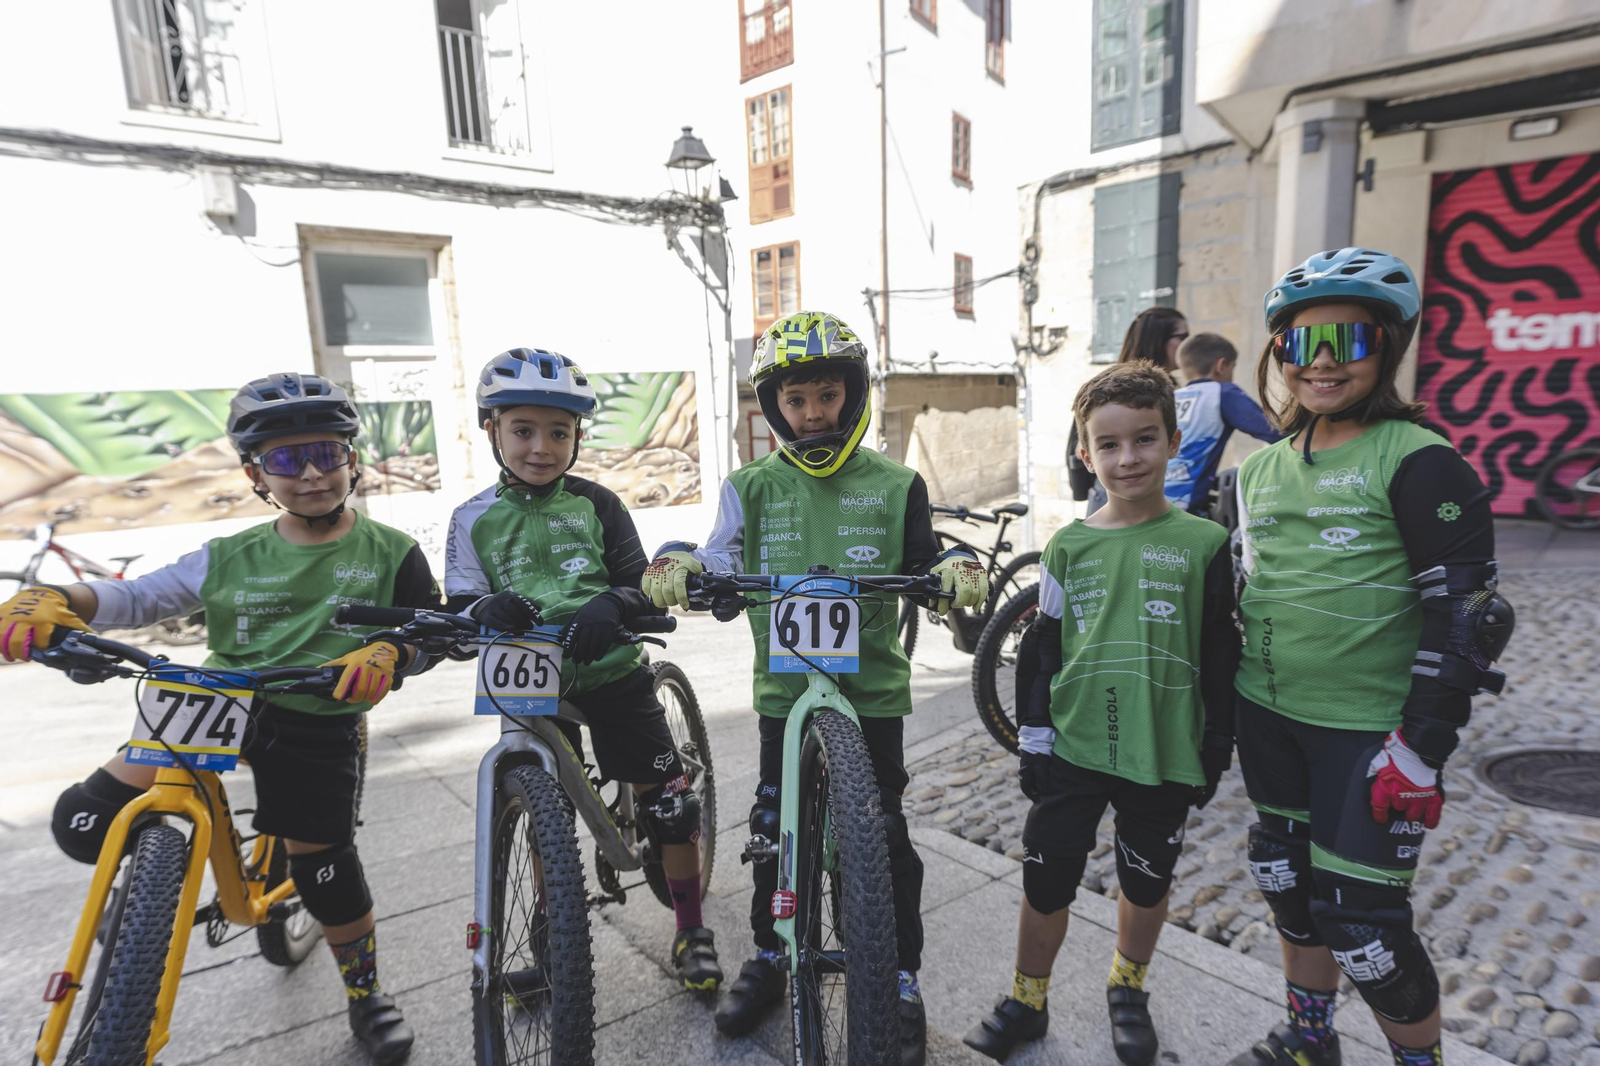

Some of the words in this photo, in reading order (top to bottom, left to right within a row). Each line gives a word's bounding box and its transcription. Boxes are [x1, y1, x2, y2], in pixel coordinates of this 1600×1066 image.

[1319, 474, 1364, 487] MACEDA
[841, 497, 884, 506] MACEDA
[1317, 506, 1369, 516] PERSAN
[550, 519, 586, 528] MACEDA
[849, 526, 887, 535] PERSAN
[763, 532, 803, 543] ABANCA
[560, 542, 592, 552] PERSAN
[499, 556, 532, 572] ABANCA
[1143, 551, 1187, 565] MACEDA
[336, 569, 377, 579] MACEDA
[1148, 581, 1186, 593] PERSAN
[338, 596, 376, 607] PERSAN
[1071, 588, 1108, 603] ABANCA
[238, 605, 293, 615] ABANCA
[778, 602, 851, 649] 619
[1261, 616, 1276, 676] ESCOLA
[493, 652, 550, 689] 665
[149, 688, 239, 747] 774
[1105, 685, 1119, 742] ESCOLA
